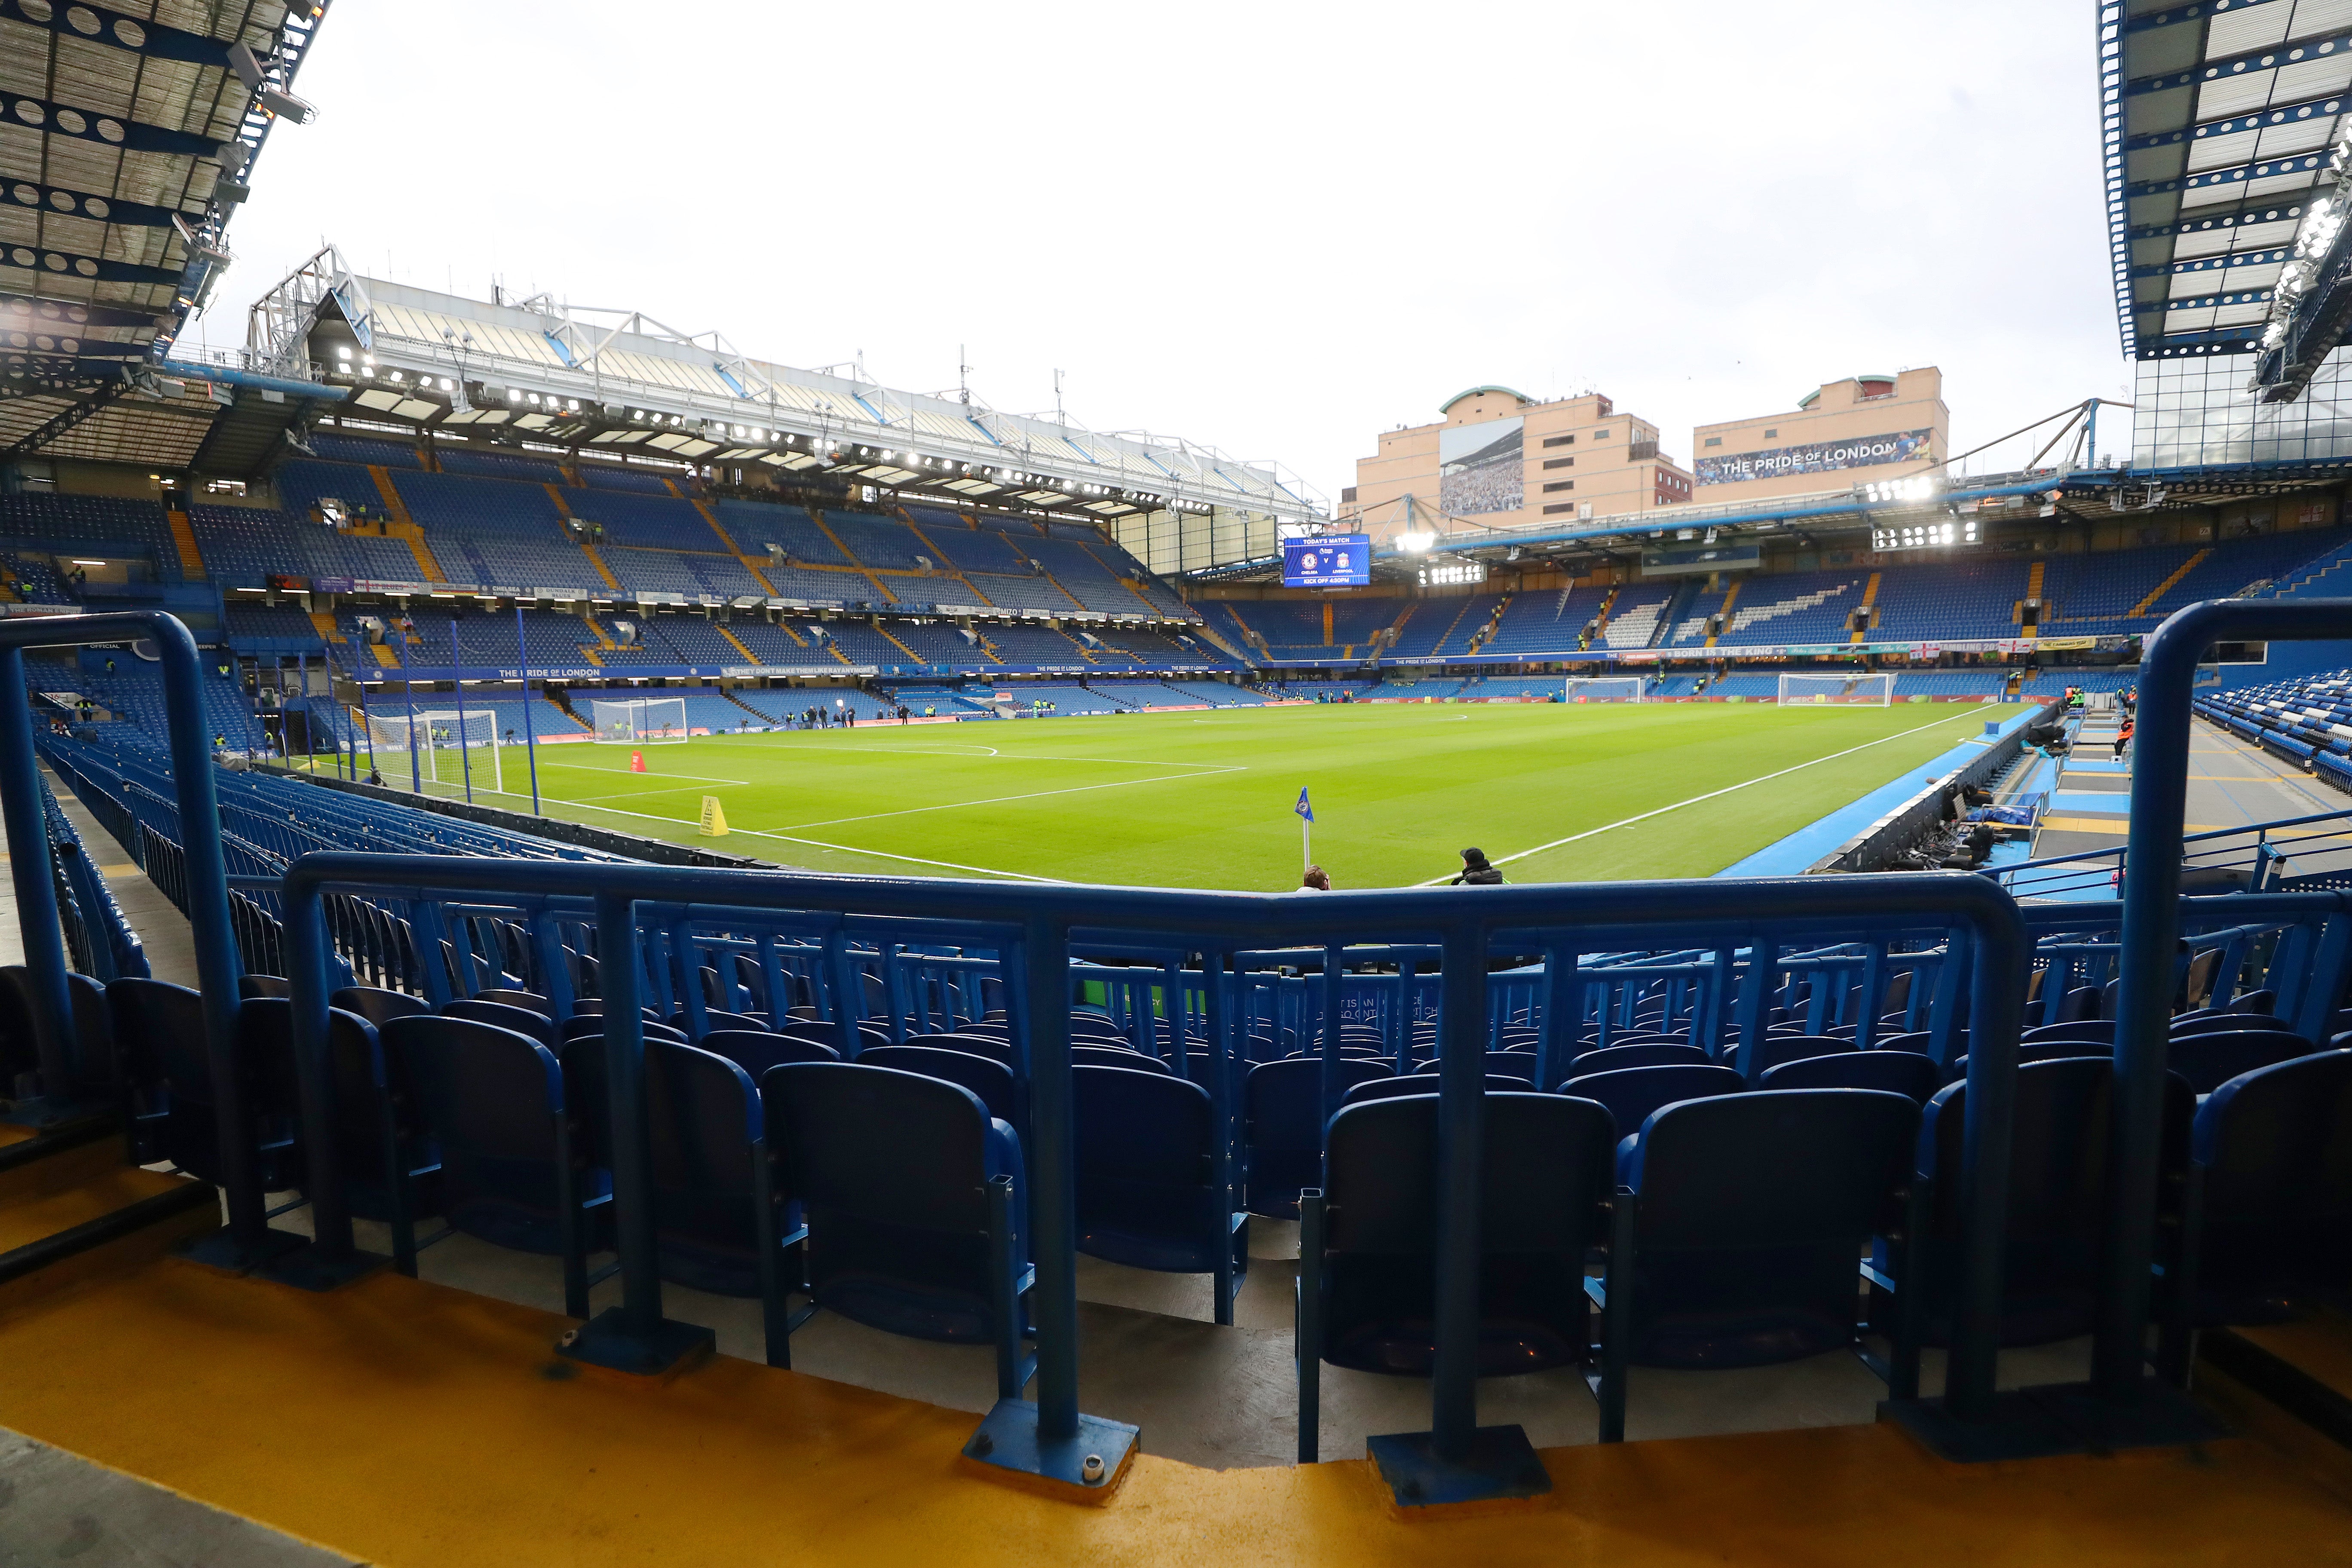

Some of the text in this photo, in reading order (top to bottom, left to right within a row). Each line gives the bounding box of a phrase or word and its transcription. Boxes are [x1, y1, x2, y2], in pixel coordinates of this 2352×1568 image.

[1722, 460, 1751, 473] THE
[1755, 454, 1801, 471] PRIDE
[1806, 452, 1821, 464] OF
[1825, 442, 1897, 462] LONDON
[1675, 649, 1702, 657] BORN
[1721, 648, 1741, 656] THE
[1746, 647, 1773, 655] KING
